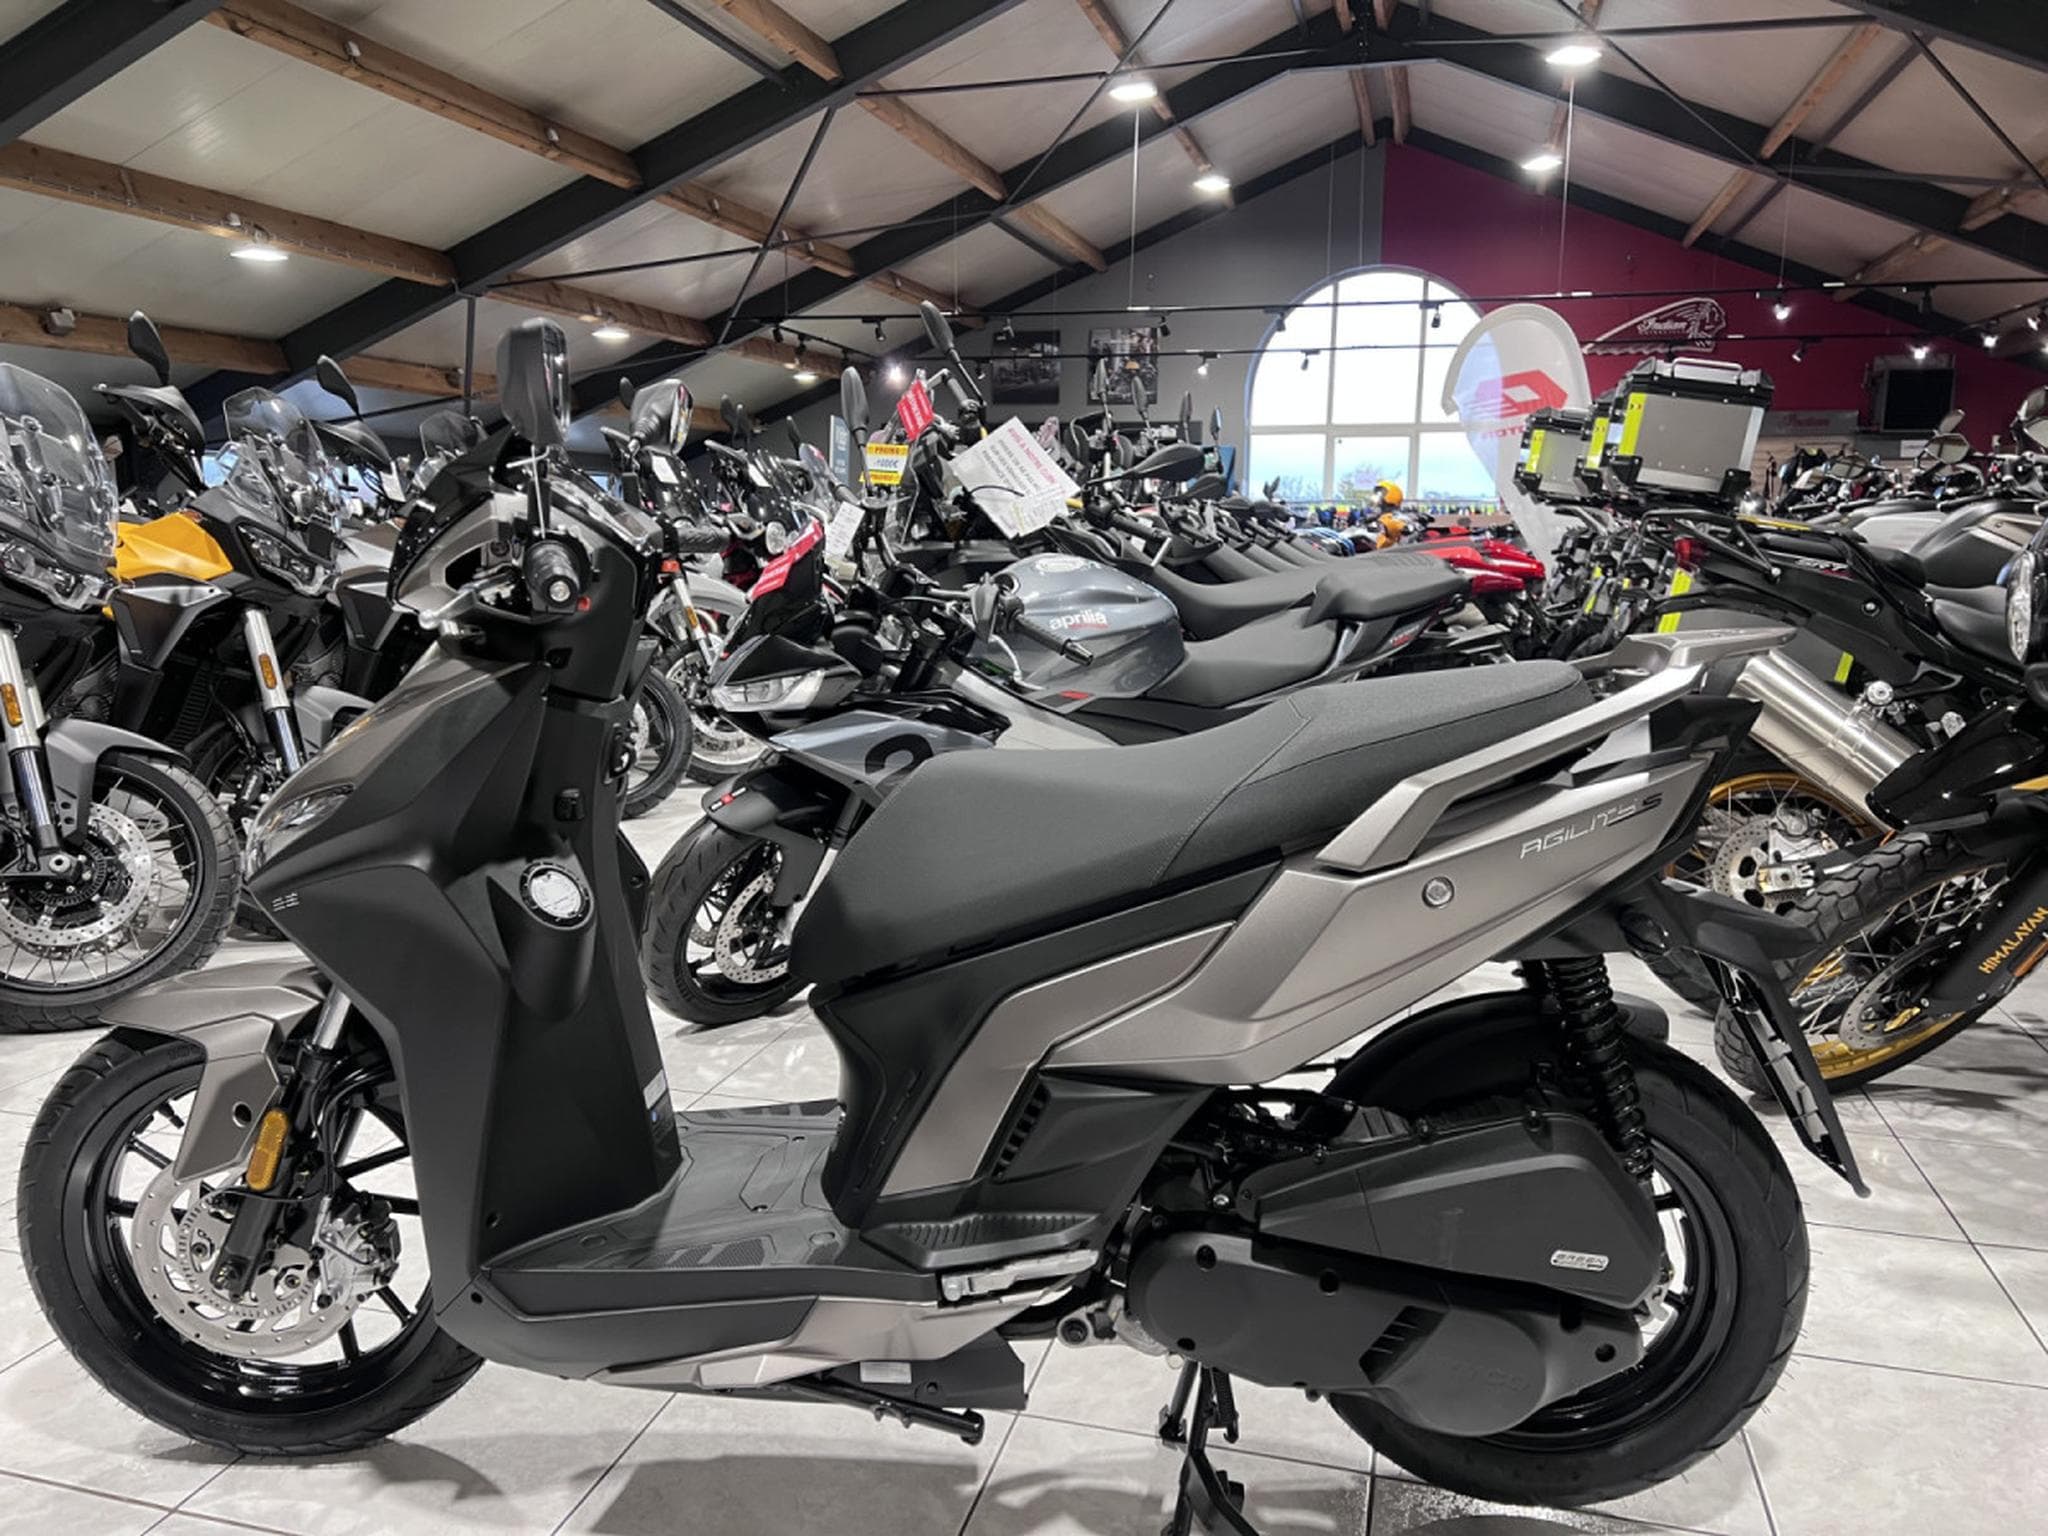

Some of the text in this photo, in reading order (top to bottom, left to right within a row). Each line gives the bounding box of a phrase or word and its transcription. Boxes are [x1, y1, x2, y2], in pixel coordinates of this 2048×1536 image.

[1637, 316, 1688, 331] Indian
[1048, 608, 1108, 630] aprilia
[1519, 803, 1637, 860] AGILITY
[1978, 906, 2048, 975] HIMALAYAN
